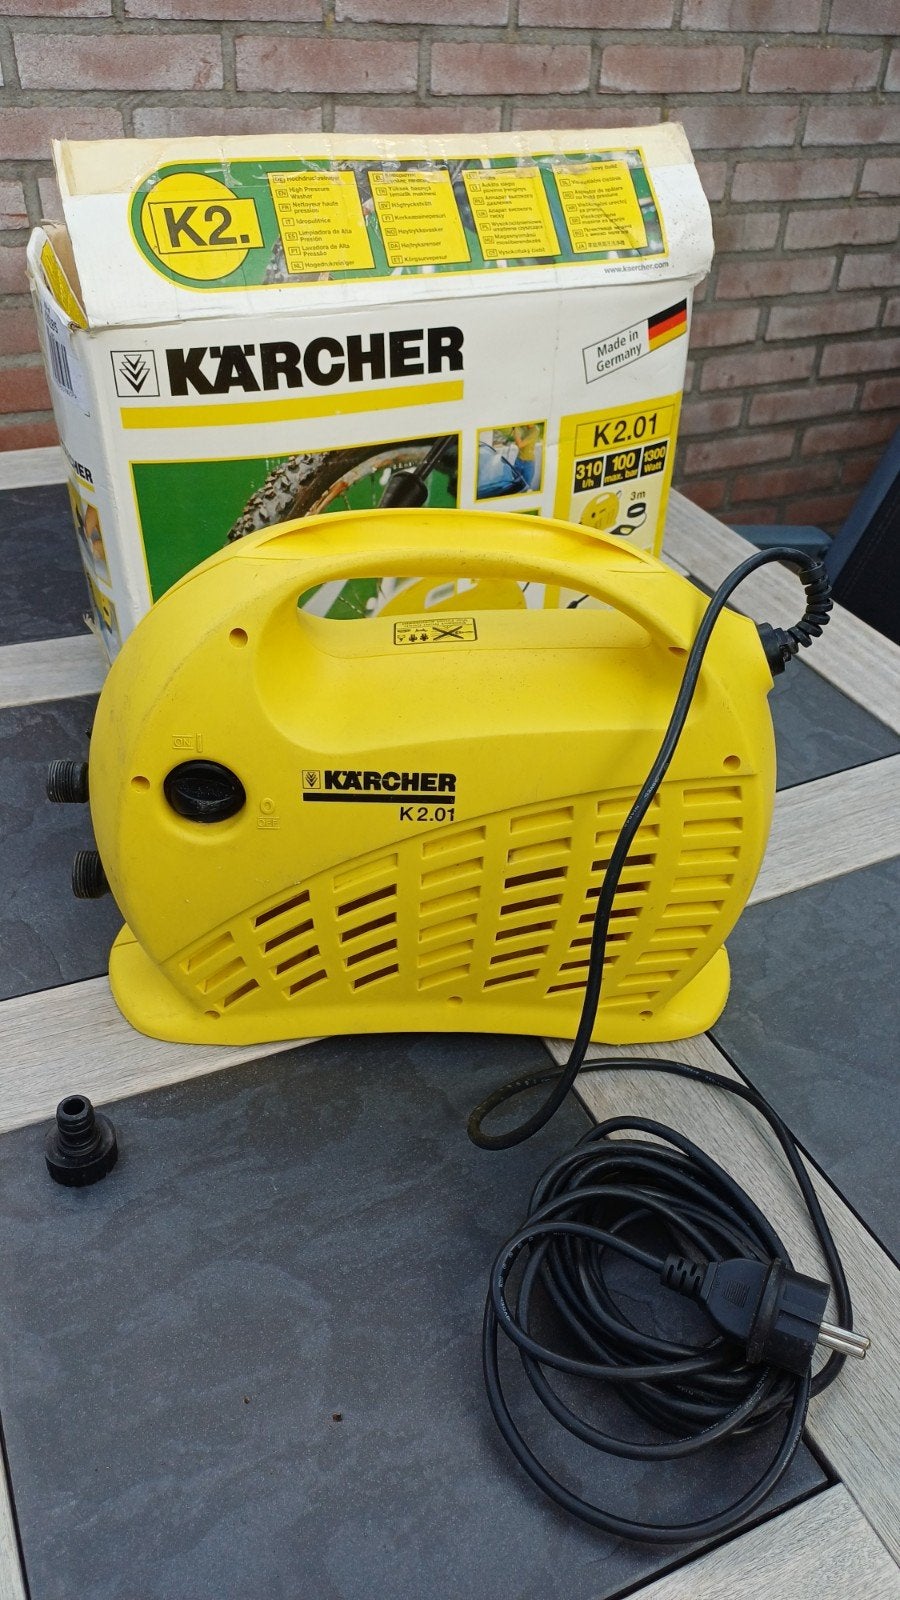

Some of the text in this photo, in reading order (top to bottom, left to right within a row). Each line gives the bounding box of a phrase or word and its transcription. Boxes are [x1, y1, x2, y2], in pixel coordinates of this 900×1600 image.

[164, 205, 250, 248] K2.
[597, 330, 639, 358] Made in
[166, 326, 465, 397] KÄRCHER
[596, 343, 642, 373] Germany
[612, 452, 635, 471] 100
[644, 447, 665, 462] 1300
[576, 461, 602, 479] 310
[604, 469, 638, 483] max. bar
[644, 461, 662, 473] Watt
[325, 770, 456, 792] KÄRCHER
